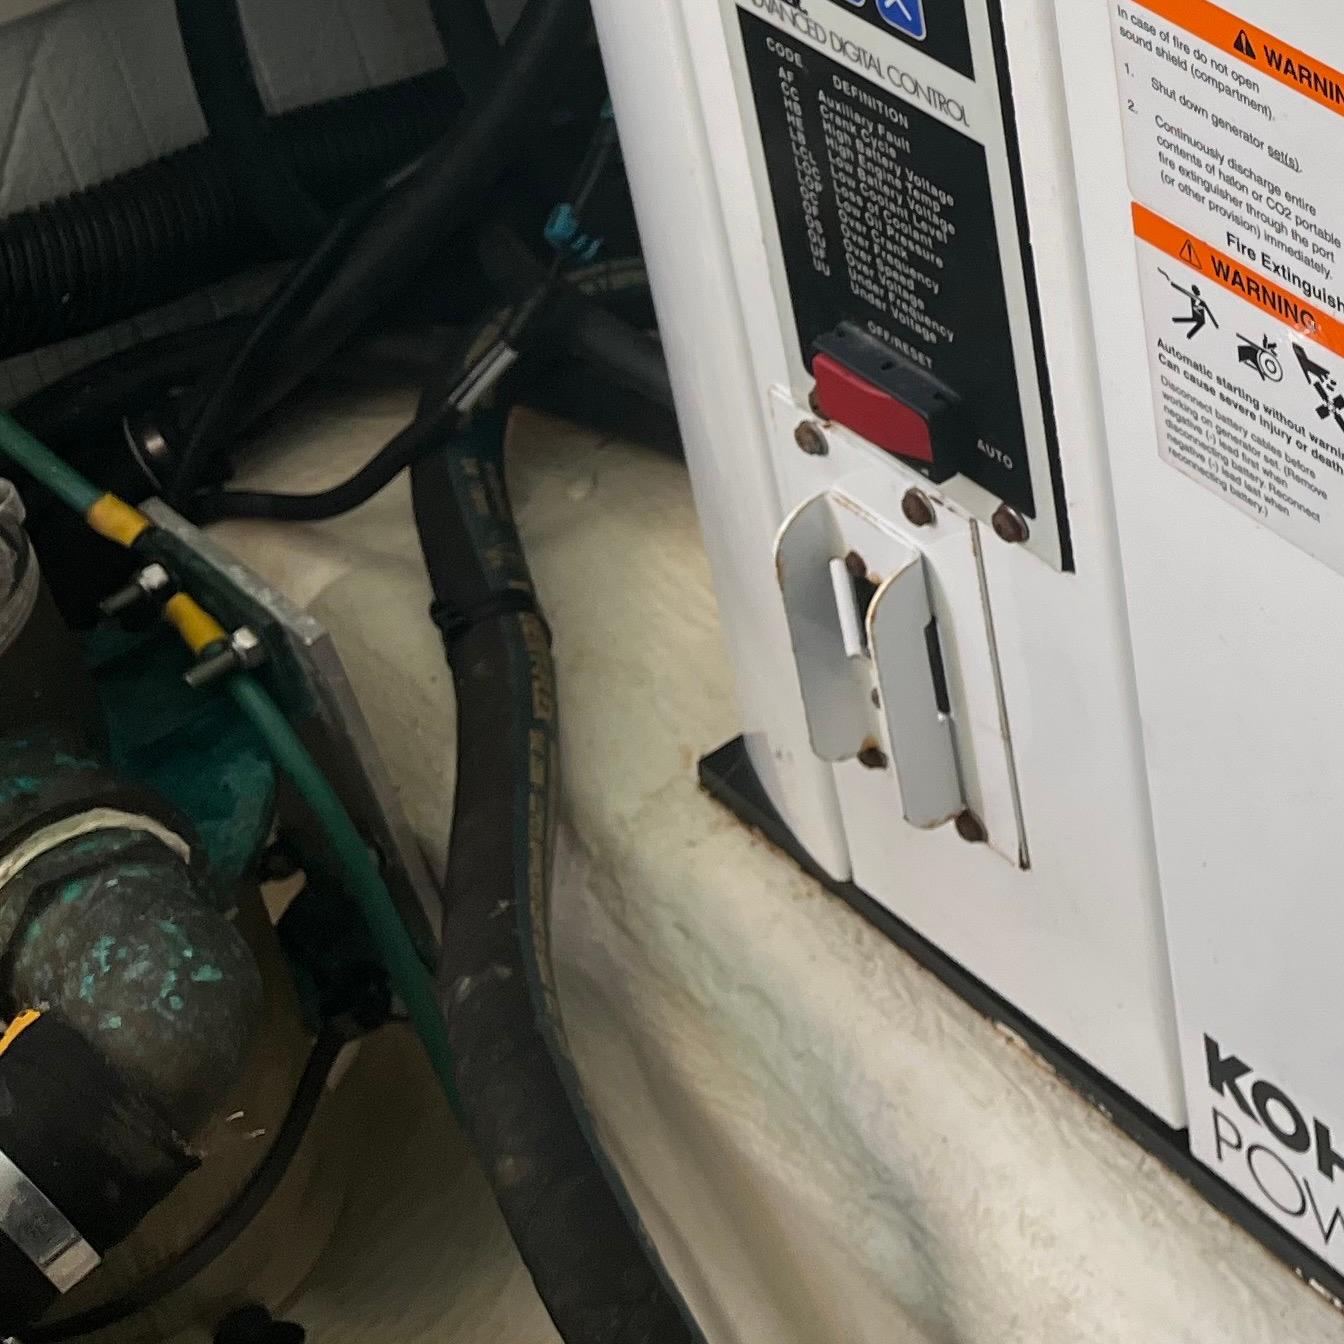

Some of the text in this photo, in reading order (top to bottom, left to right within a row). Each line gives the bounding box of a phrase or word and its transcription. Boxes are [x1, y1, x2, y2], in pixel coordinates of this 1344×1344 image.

[766, 37, 908, 128] CODE DEFINITION
[831, 29, 885, 79] DIGITAL
[887, 64, 970, 128] CONTROL
[1117, 4, 1259, 93] In case of fire do not open
[1119, 26, 1152, 51] sound
[1155, 46, 1187, 71] shield
[778, 66, 910, 152] AF Auxiliary Fault
[780, 81, 896, 158] CC Crank Cycle
[1124, 62, 1134, 77] 1.
[1151, 76, 1176, 101] Shut
[1178, 94, 1208, 118] down
[1211, 113, 1264, 149] generator
[822, 119, 953, 205] High Battery Voltage
[1154, 114, 1224, 165] Continuously
[1227, 158, 1281, 196] discharge
[1284, 191, 1316, 216] entire
[1156, 135, 1341, 248] contents of halon or CO2 portable
[1158, 151, 1334, 263] fire extinguisher through the port
[1160, 169, 1332, 280] (or other provision) immediately.
[1226, 231, 1255, 260] Fire
[1210, 255, 1315, 328] WARNING
[867, 320, 931, 368] OFF/RESET
[1157, 337, 1212, 379] Automatic
[1216, 375, 1259, 410] starting
[1262, 404, 1305, 437] without
[1158, 352, 1180, 373] Can
[1183, 370, 1215, 396] cause
[1219, 392, 1256, 420] severe
[1259, 414, 1291, 444] injury
[1295, 439, 1307, 452] or
[977, 439, 1012, 468] AUTO
